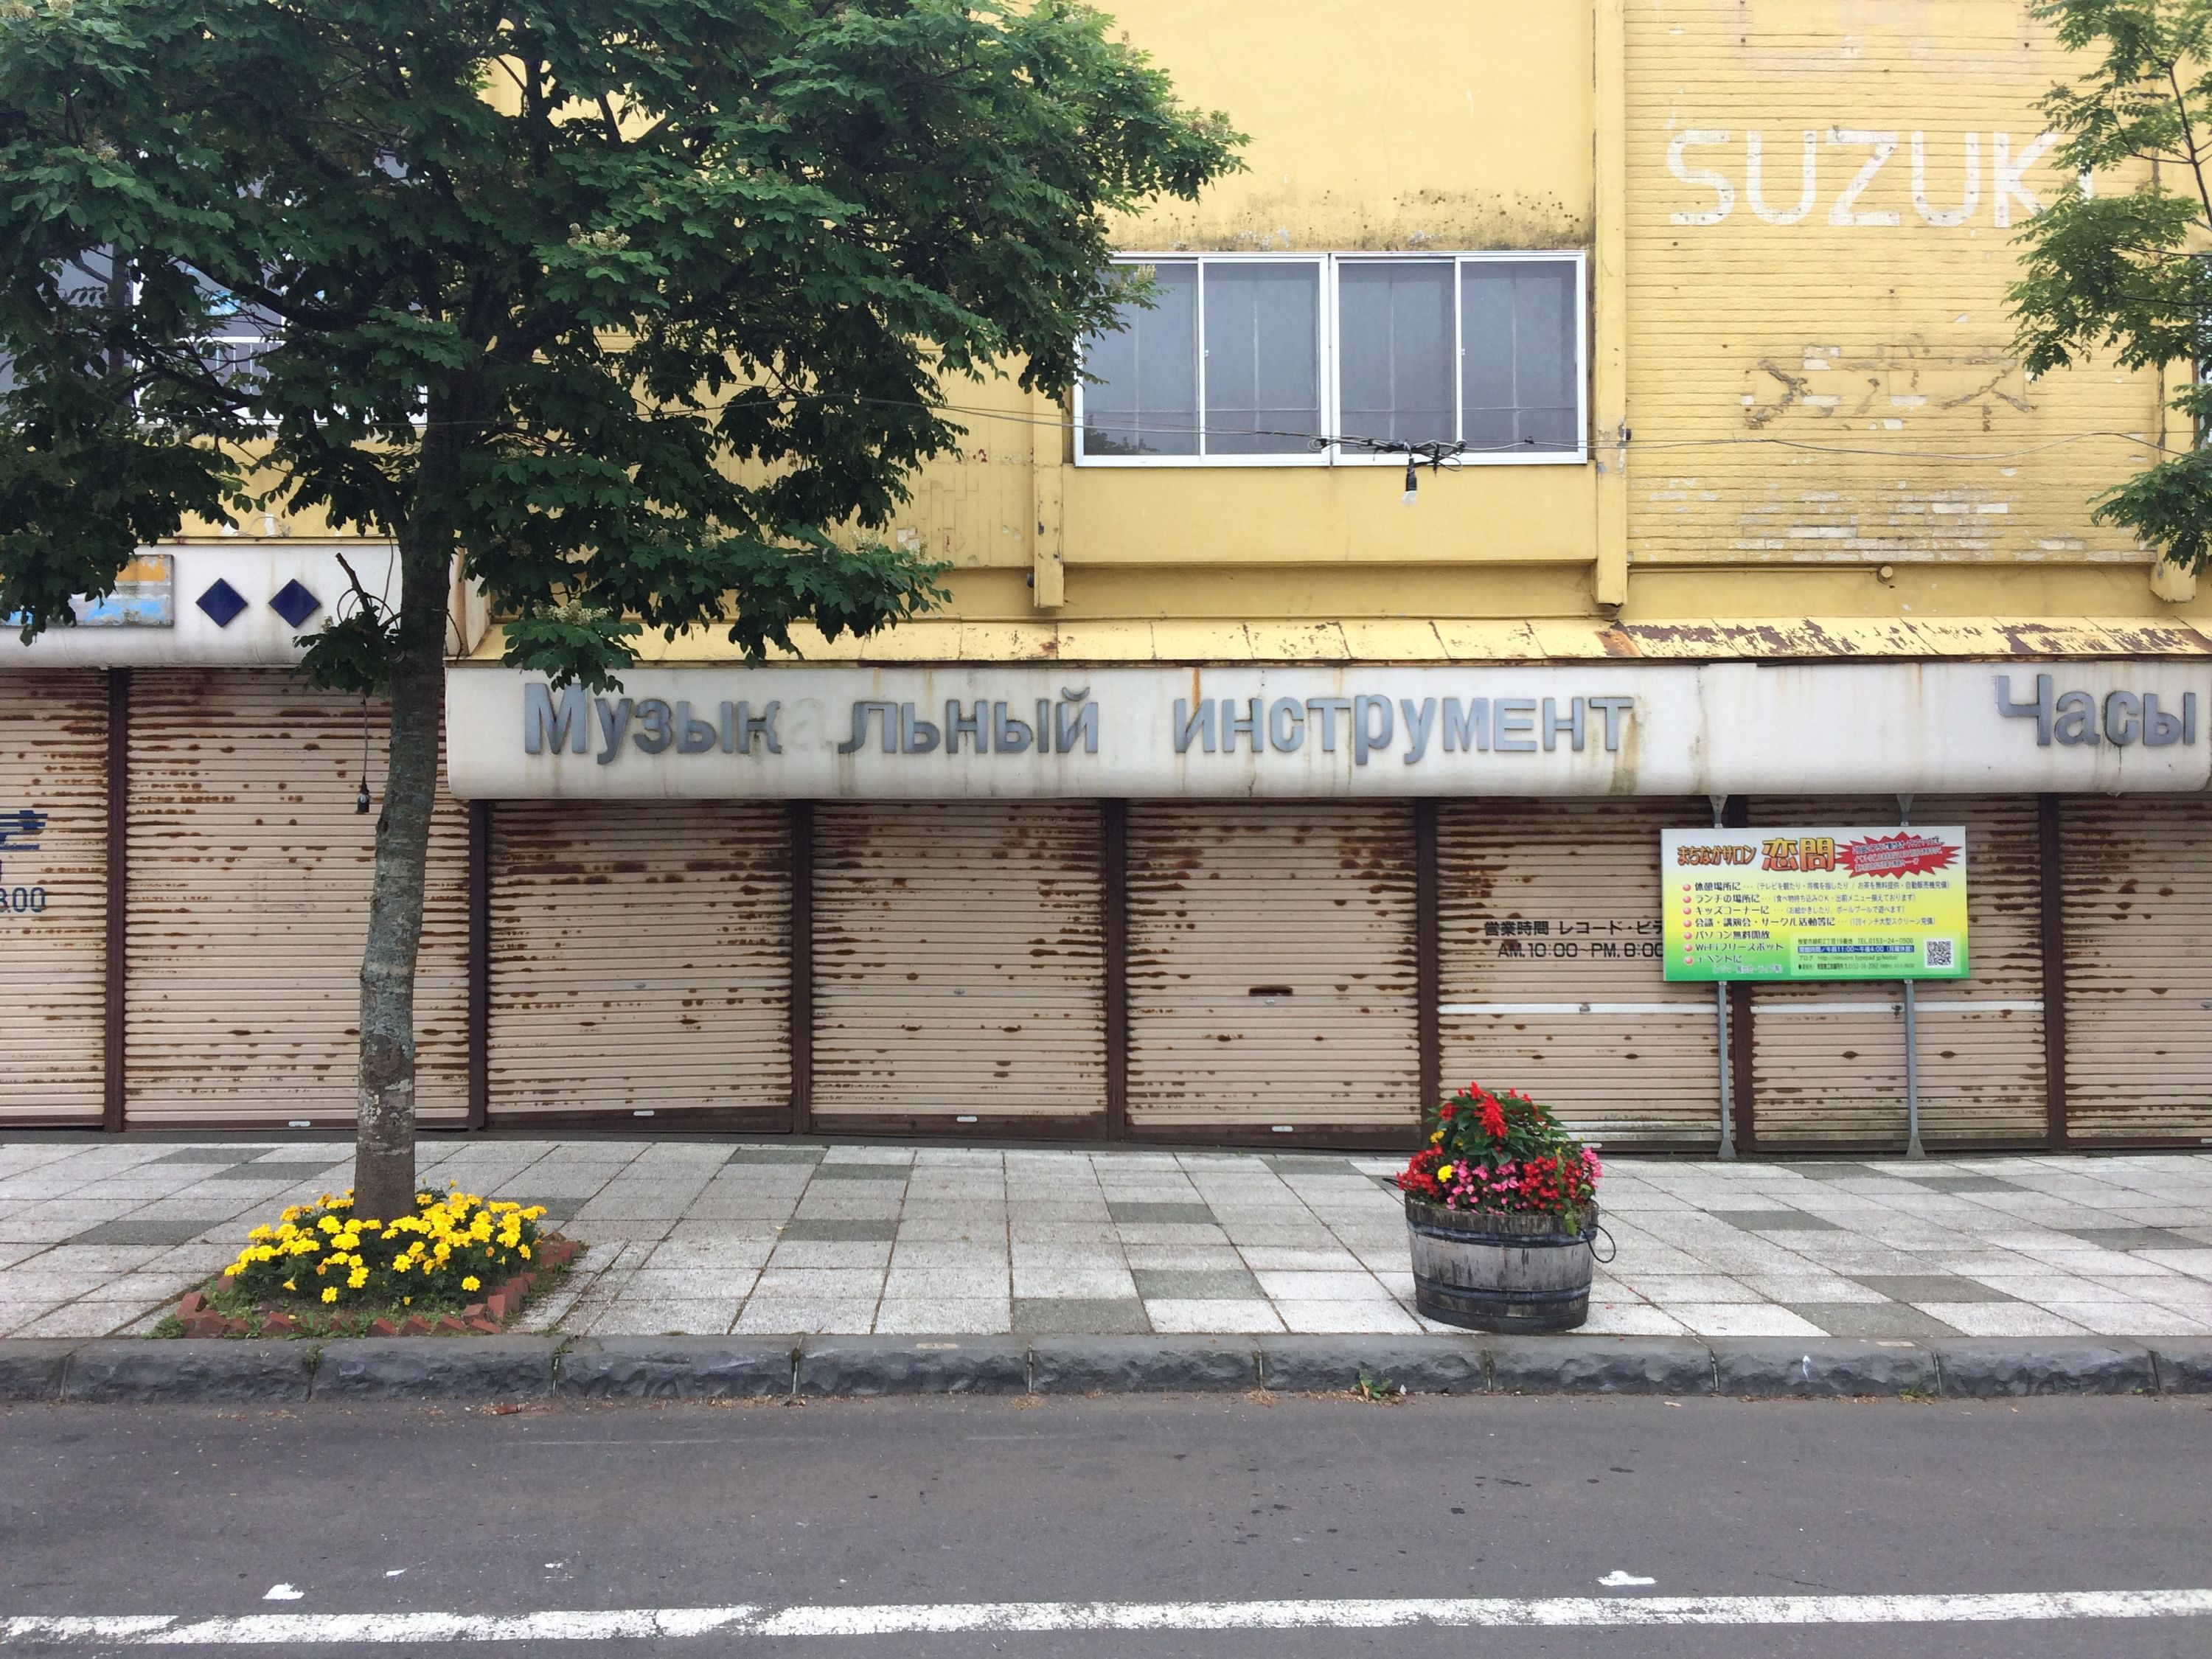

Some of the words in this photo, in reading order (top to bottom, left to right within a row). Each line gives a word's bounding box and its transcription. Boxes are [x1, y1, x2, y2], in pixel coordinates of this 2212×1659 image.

[1996, 674, 2196, 746] Часы
[1677, 845, 1757, 866] まちなかサロン
[1761, 837, 1835, 872] 恋問
[1694, 881, 1742, 891] 休憩場所に
[1695, 894, 1761, 904] ランチの場所に
[1695, 905, 1770, 915] キッズコーナーに
[1484, 921, 1549, 936] 営業時間
[1695, 930, 1770, 940] パソコン無料開放
